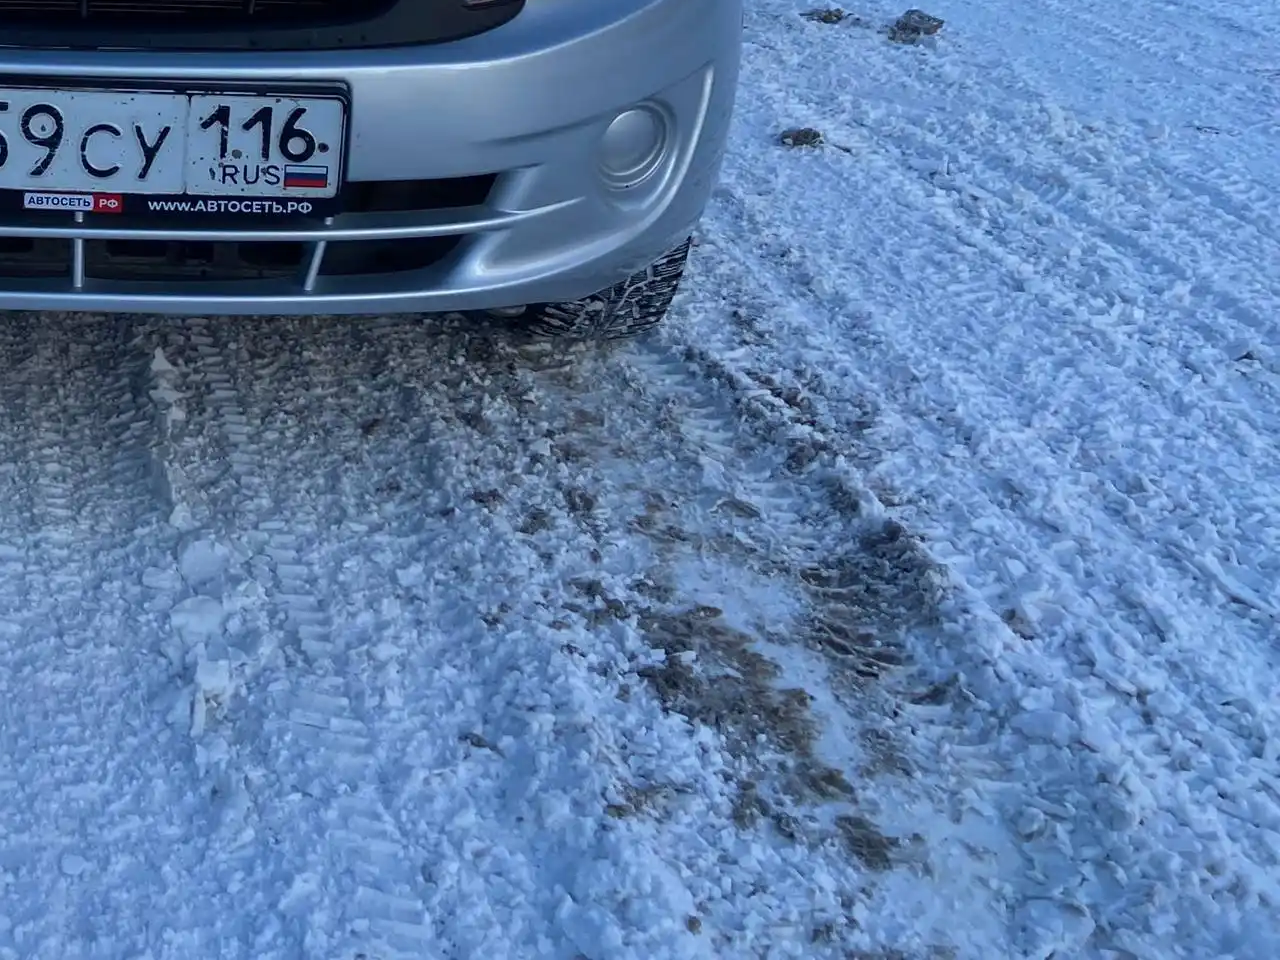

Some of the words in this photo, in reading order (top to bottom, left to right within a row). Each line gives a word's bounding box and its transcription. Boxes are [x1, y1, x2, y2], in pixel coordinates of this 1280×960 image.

[200, 103, 317, 163] 116
[221, 163, 281, 185] RUS
[27, 195, 91, 207] АВТОСЕТЬ
[99, 198, 119, 208] РФ
[147, 200, 313, 214] www.АВТОСЕТЬ.РФ
